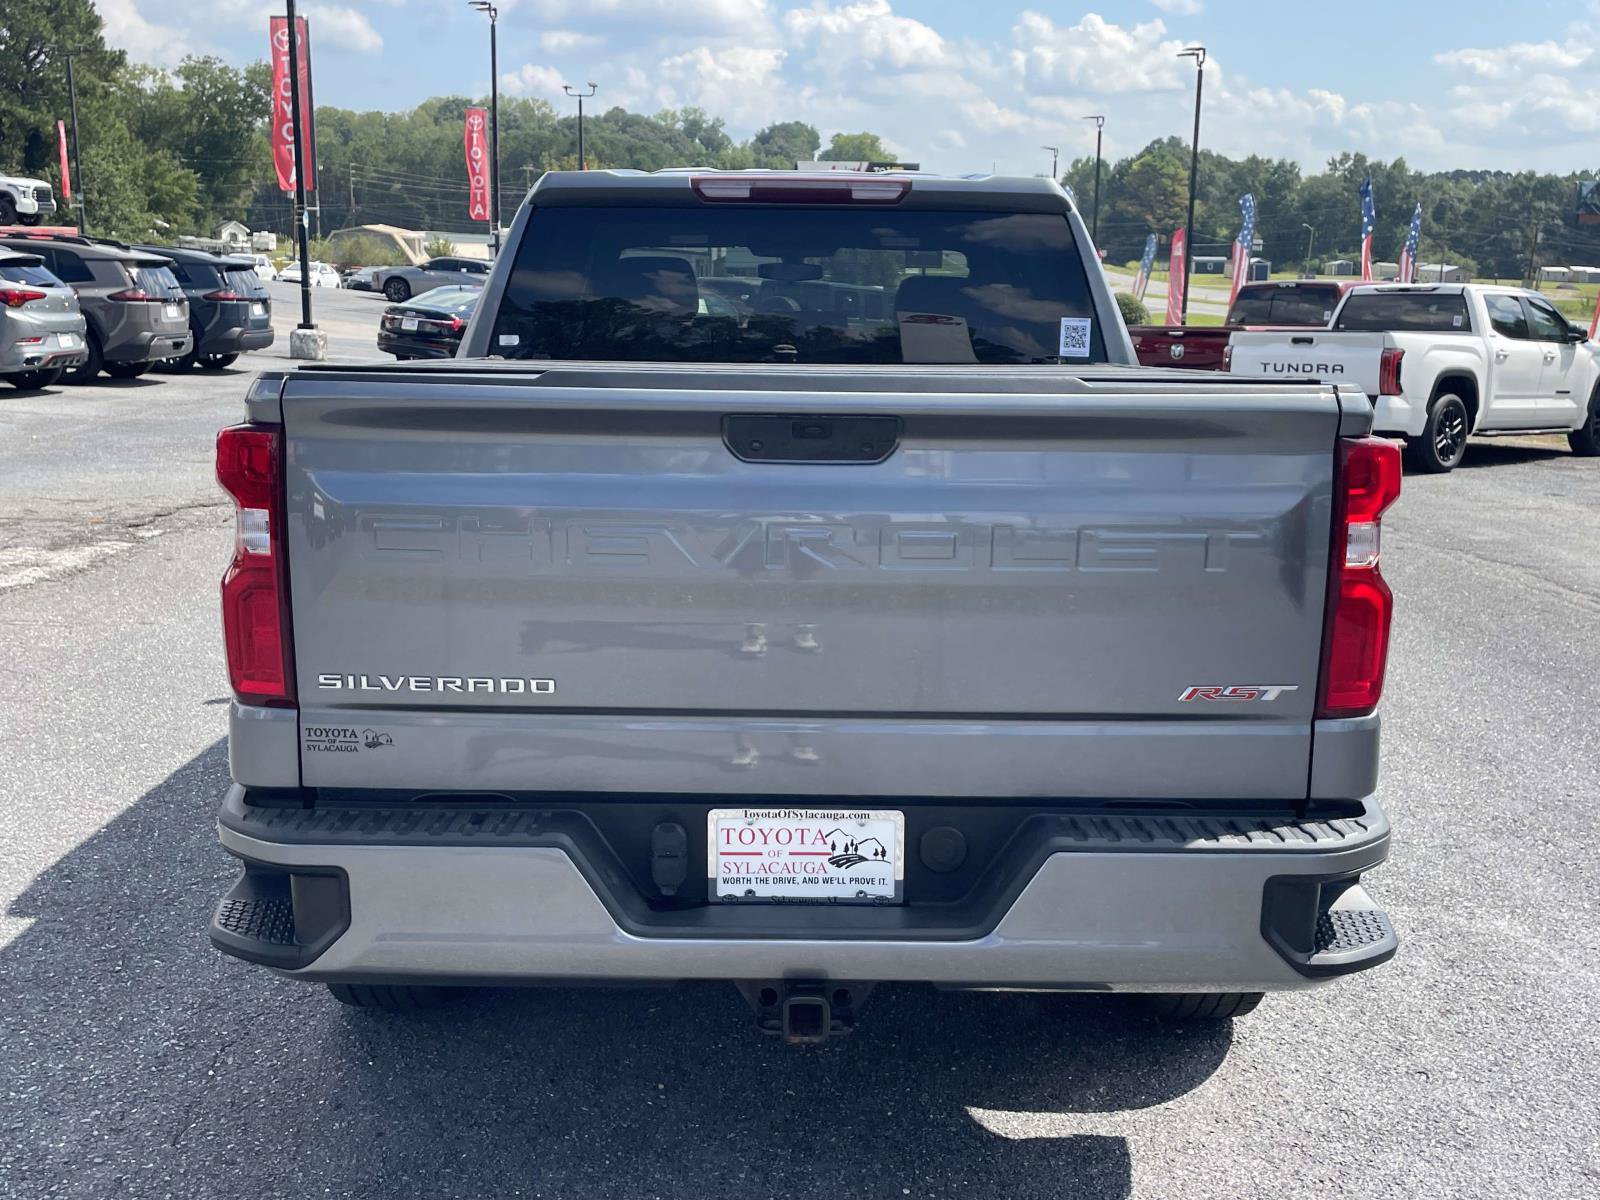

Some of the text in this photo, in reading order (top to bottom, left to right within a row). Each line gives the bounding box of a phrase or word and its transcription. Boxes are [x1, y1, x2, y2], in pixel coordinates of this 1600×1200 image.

[470, 132, 485, 215] TOYOTA
[1260, 362, 1344, 374] TUNDRA
[356, 513, 1264, 574] CHEVROLET
[318, 674, 556, 694] SILVERADO
[1178, 684, 1299, 701] RST
[305, 727, 359, 739] TOYOTA
[306, 744, 359, 753] SYLACAUGA
[743, 809, 871, 820] ToyotaOfSylacauga.com
[720, 828, 828, 846] TOYOTA
[767, 849, 784, 858] OF
[722, 861, 829, 875] SYLACAUGA
[722, 877, 888, 886] WORTH THE DRIVE, AND WE'LL PROVE IT.
